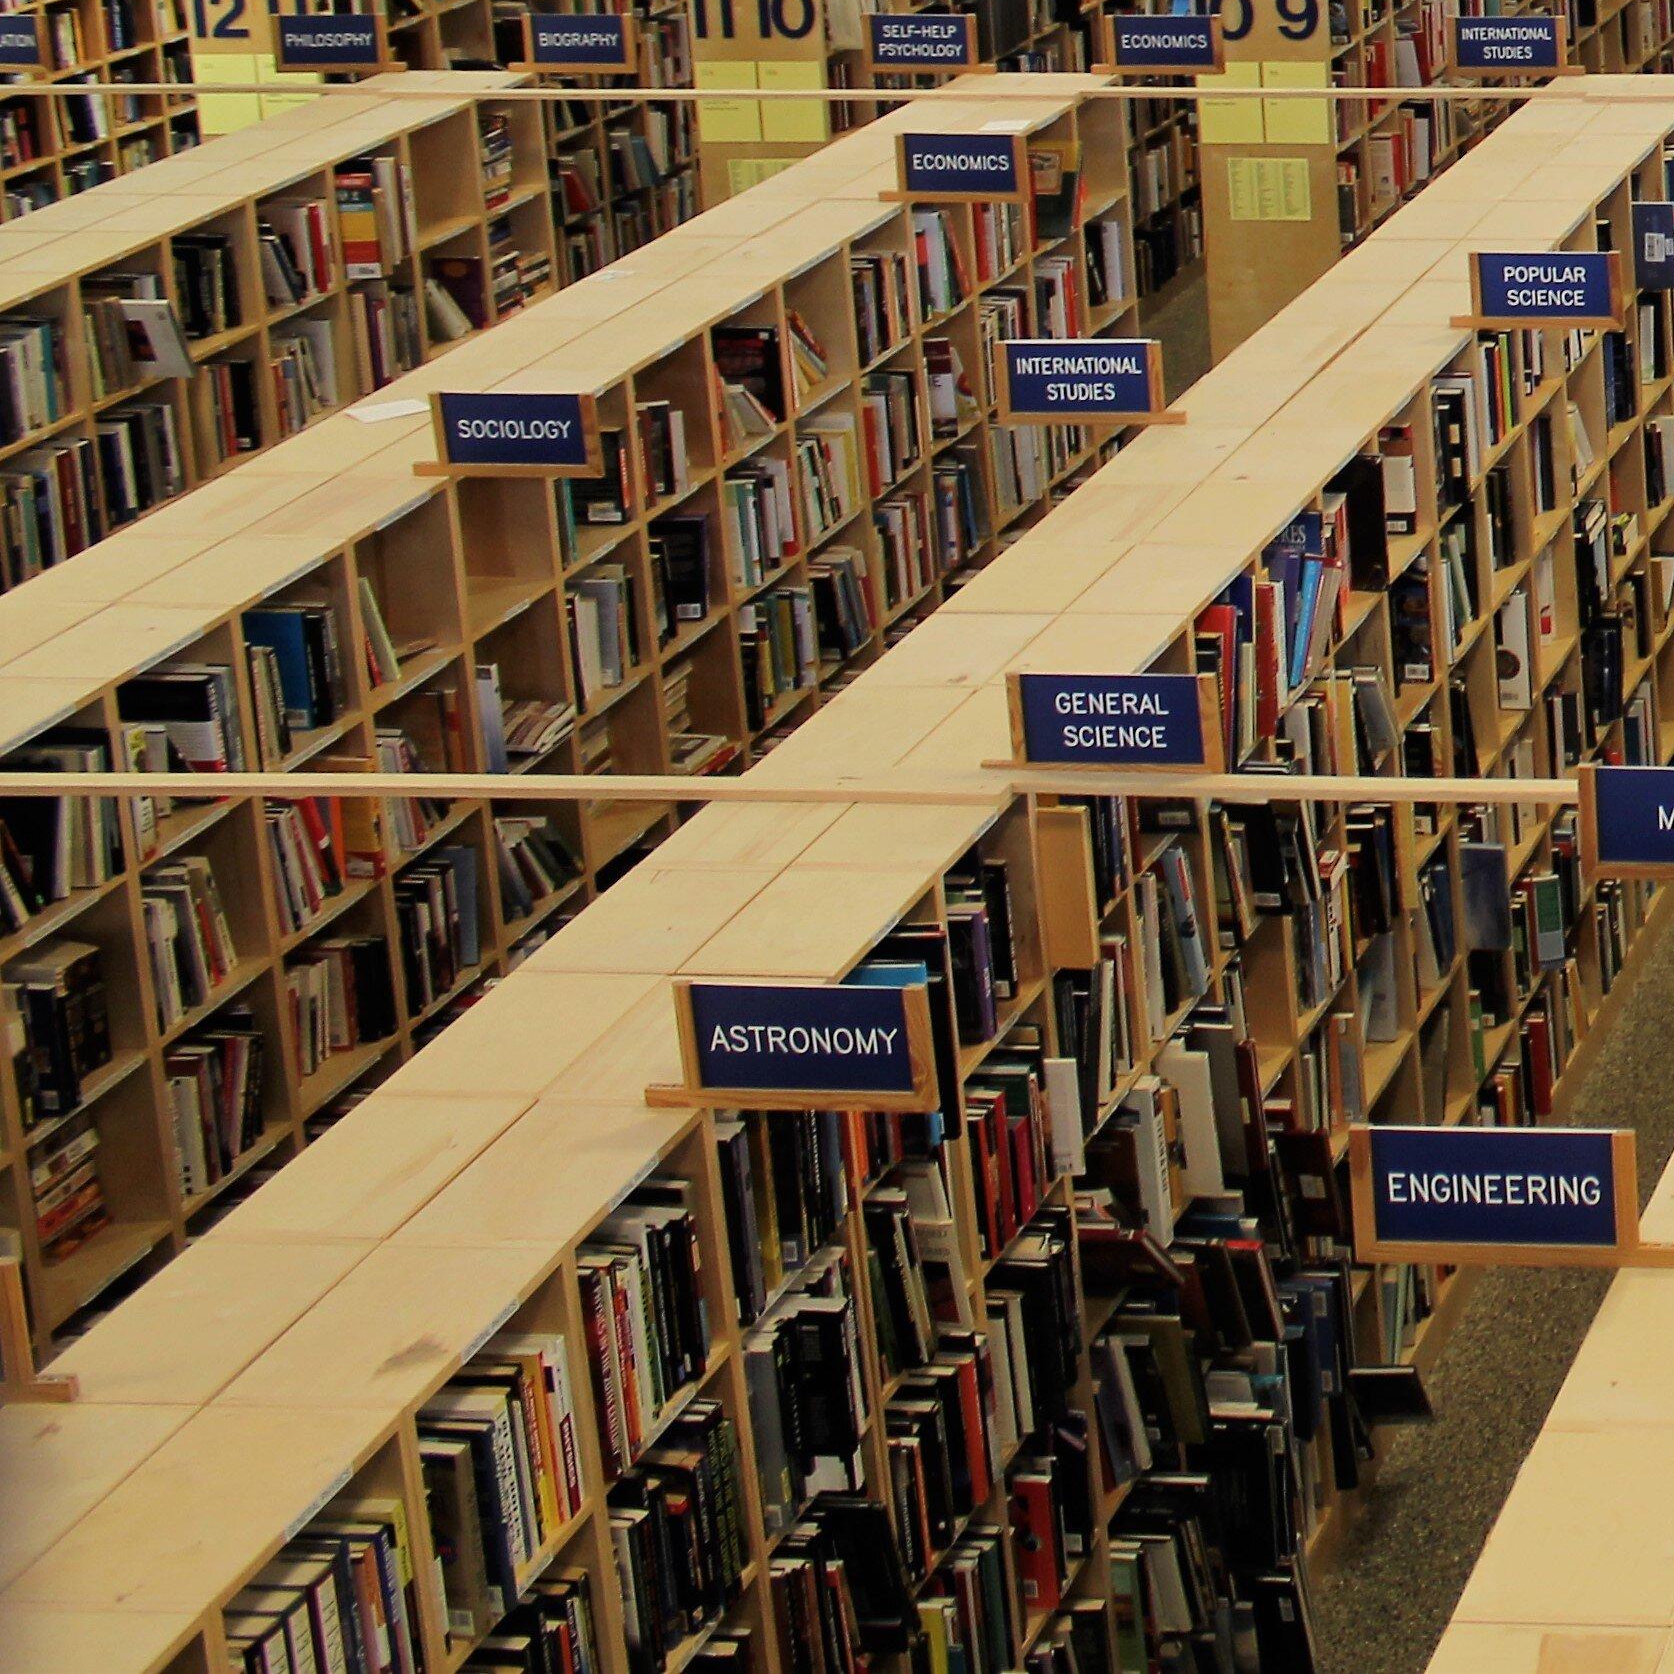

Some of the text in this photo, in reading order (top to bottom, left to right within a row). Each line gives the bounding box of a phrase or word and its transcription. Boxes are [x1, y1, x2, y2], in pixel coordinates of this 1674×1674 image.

[284, 32, 373, 48] PHILOSOPHY
[538, 32, 618, 47] BIOGRAPHY
[882, 24, 957, 39] SELF-HELP
[1461, 26, 1552, 41] INTERNATIONAL
[878, 42, 963, 58] PSYCHOLOGY
[1120, 34, 1208, 49] ECONOMICS
[1483, 45, 1533, 60] STUDIES
[912, 153, 1010, 171] ECONOMICS
[1503, 265, 1587, 283] POPULAR
[1506, 289, 1586, 307] SCIENCE
[1016, 356, 1143, 375] INTERNATIONAL
[1046, 382, 1116, 401] STUDIES
[457, 419, 571, 440] SOCIOLOGY
[1055, 692, 1170, 716] GENERAL
[1063, 725, 1168, 749] SCIENCE
[710, 1025, 898, 1055] ASTRONOMY
[1388, 1172, 1601, 1206] ENGINEERING
